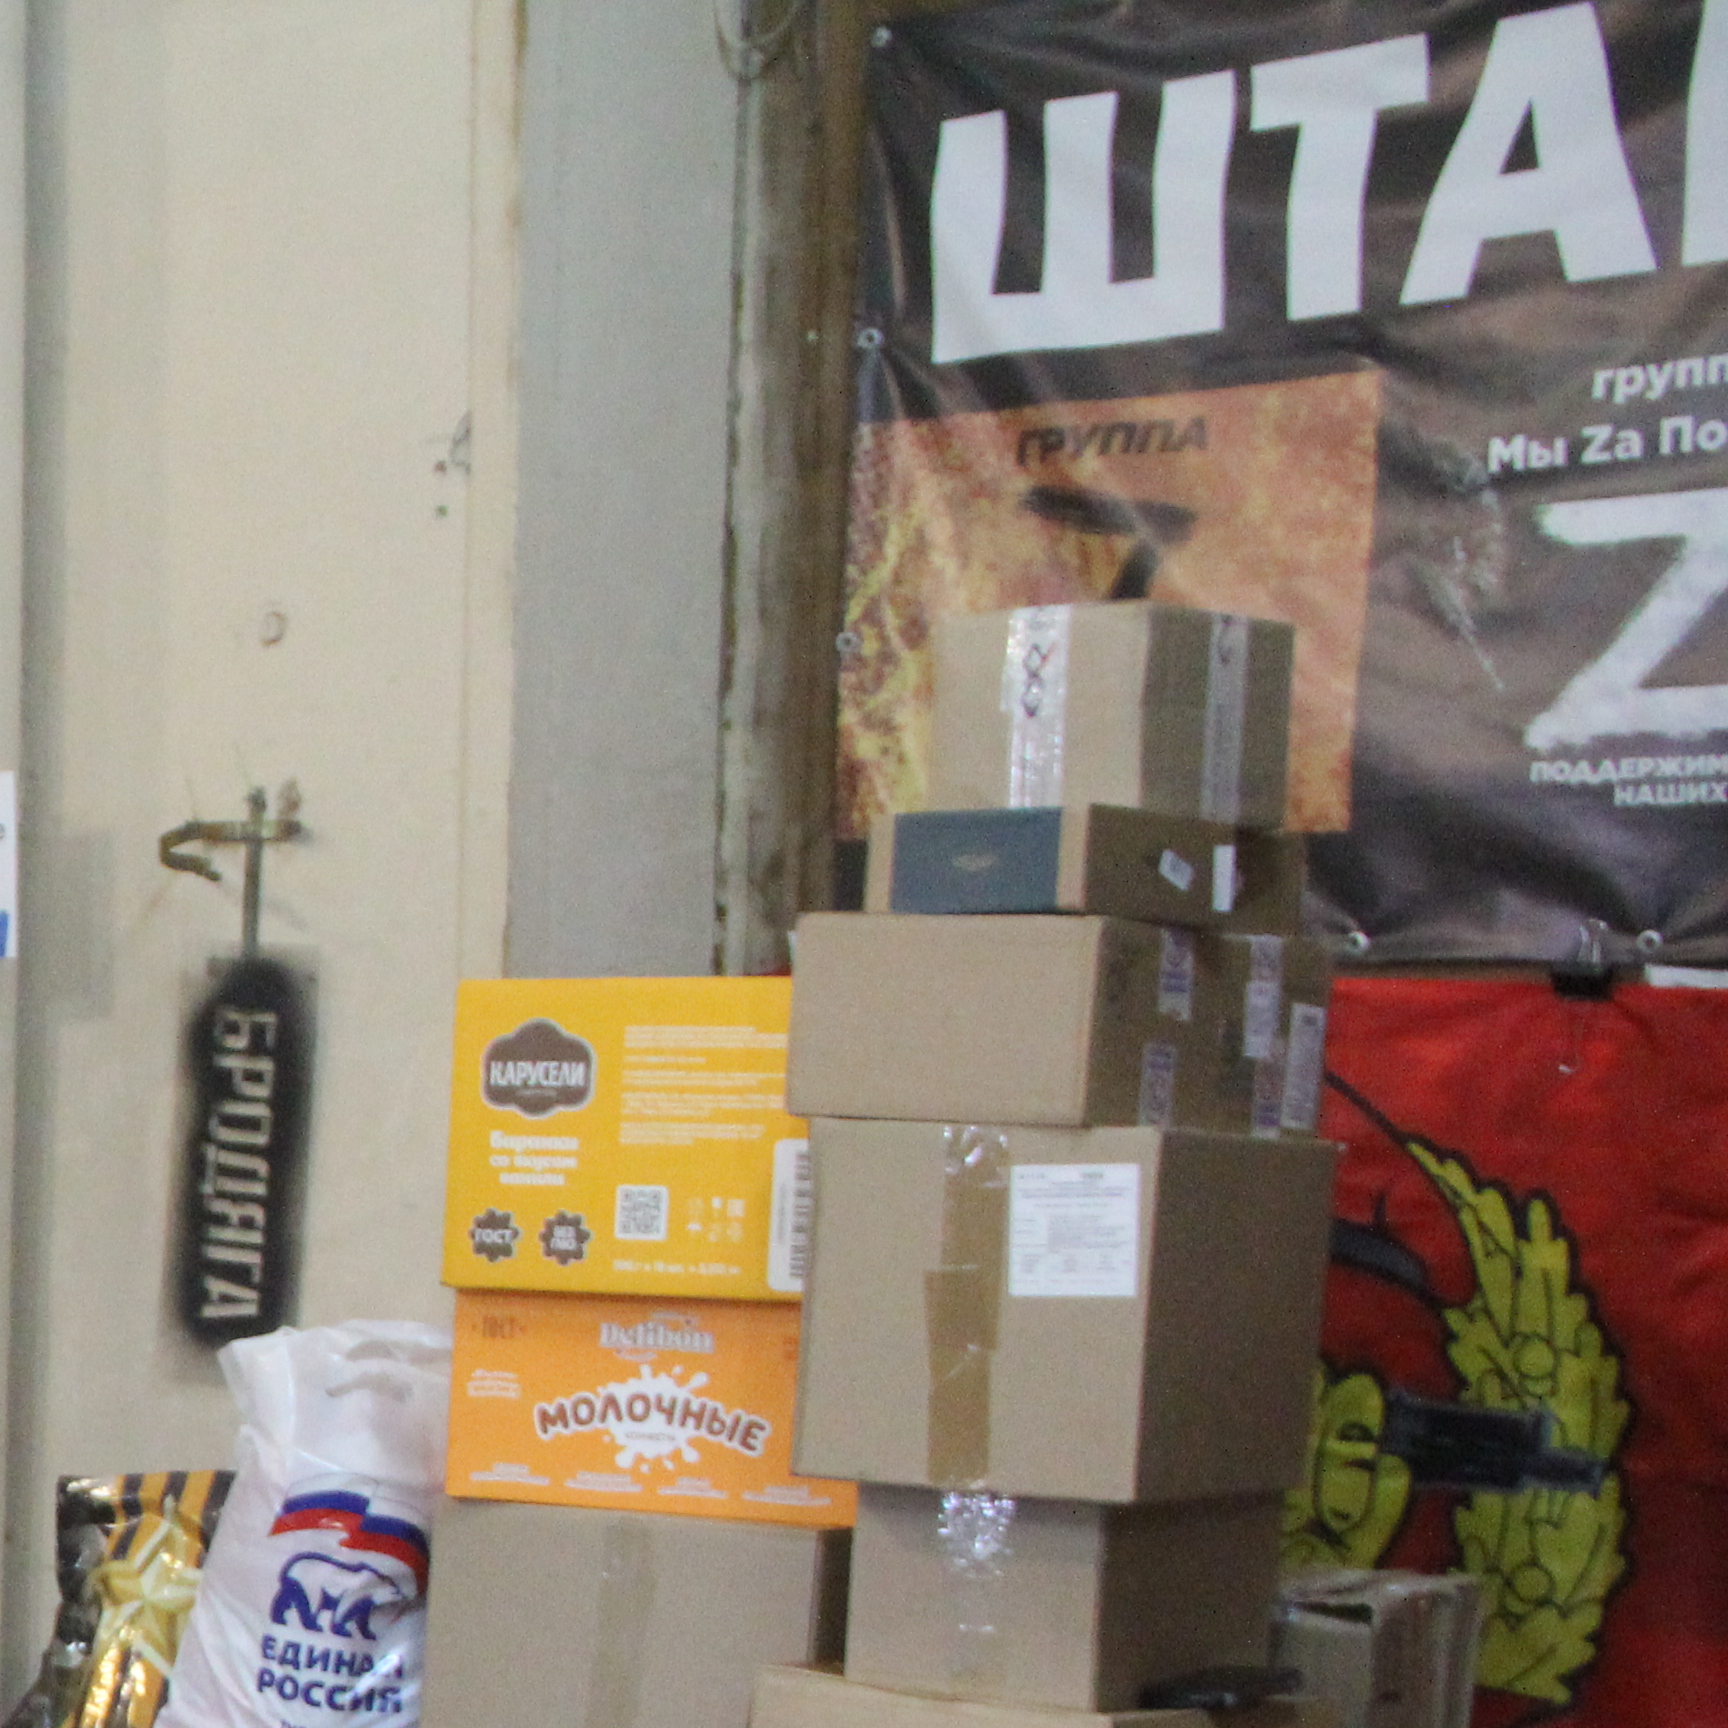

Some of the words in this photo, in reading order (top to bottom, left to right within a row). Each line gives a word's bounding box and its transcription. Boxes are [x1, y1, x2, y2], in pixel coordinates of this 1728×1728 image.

[1016, 416, 1208, 468] ГРУППА
[1486, 434, 1569, 473] Мы
[1580, 424, 1643, 464] Za
[489, 1060, 586, 1088] КАРУСЕЛИ
[199, 1008, 279, 1320] БРОДЯГА
[473, 1227, 514, 1245] ГОСТ
[537, 1392, 767, 1454] МОЛОЧНЫЕ
